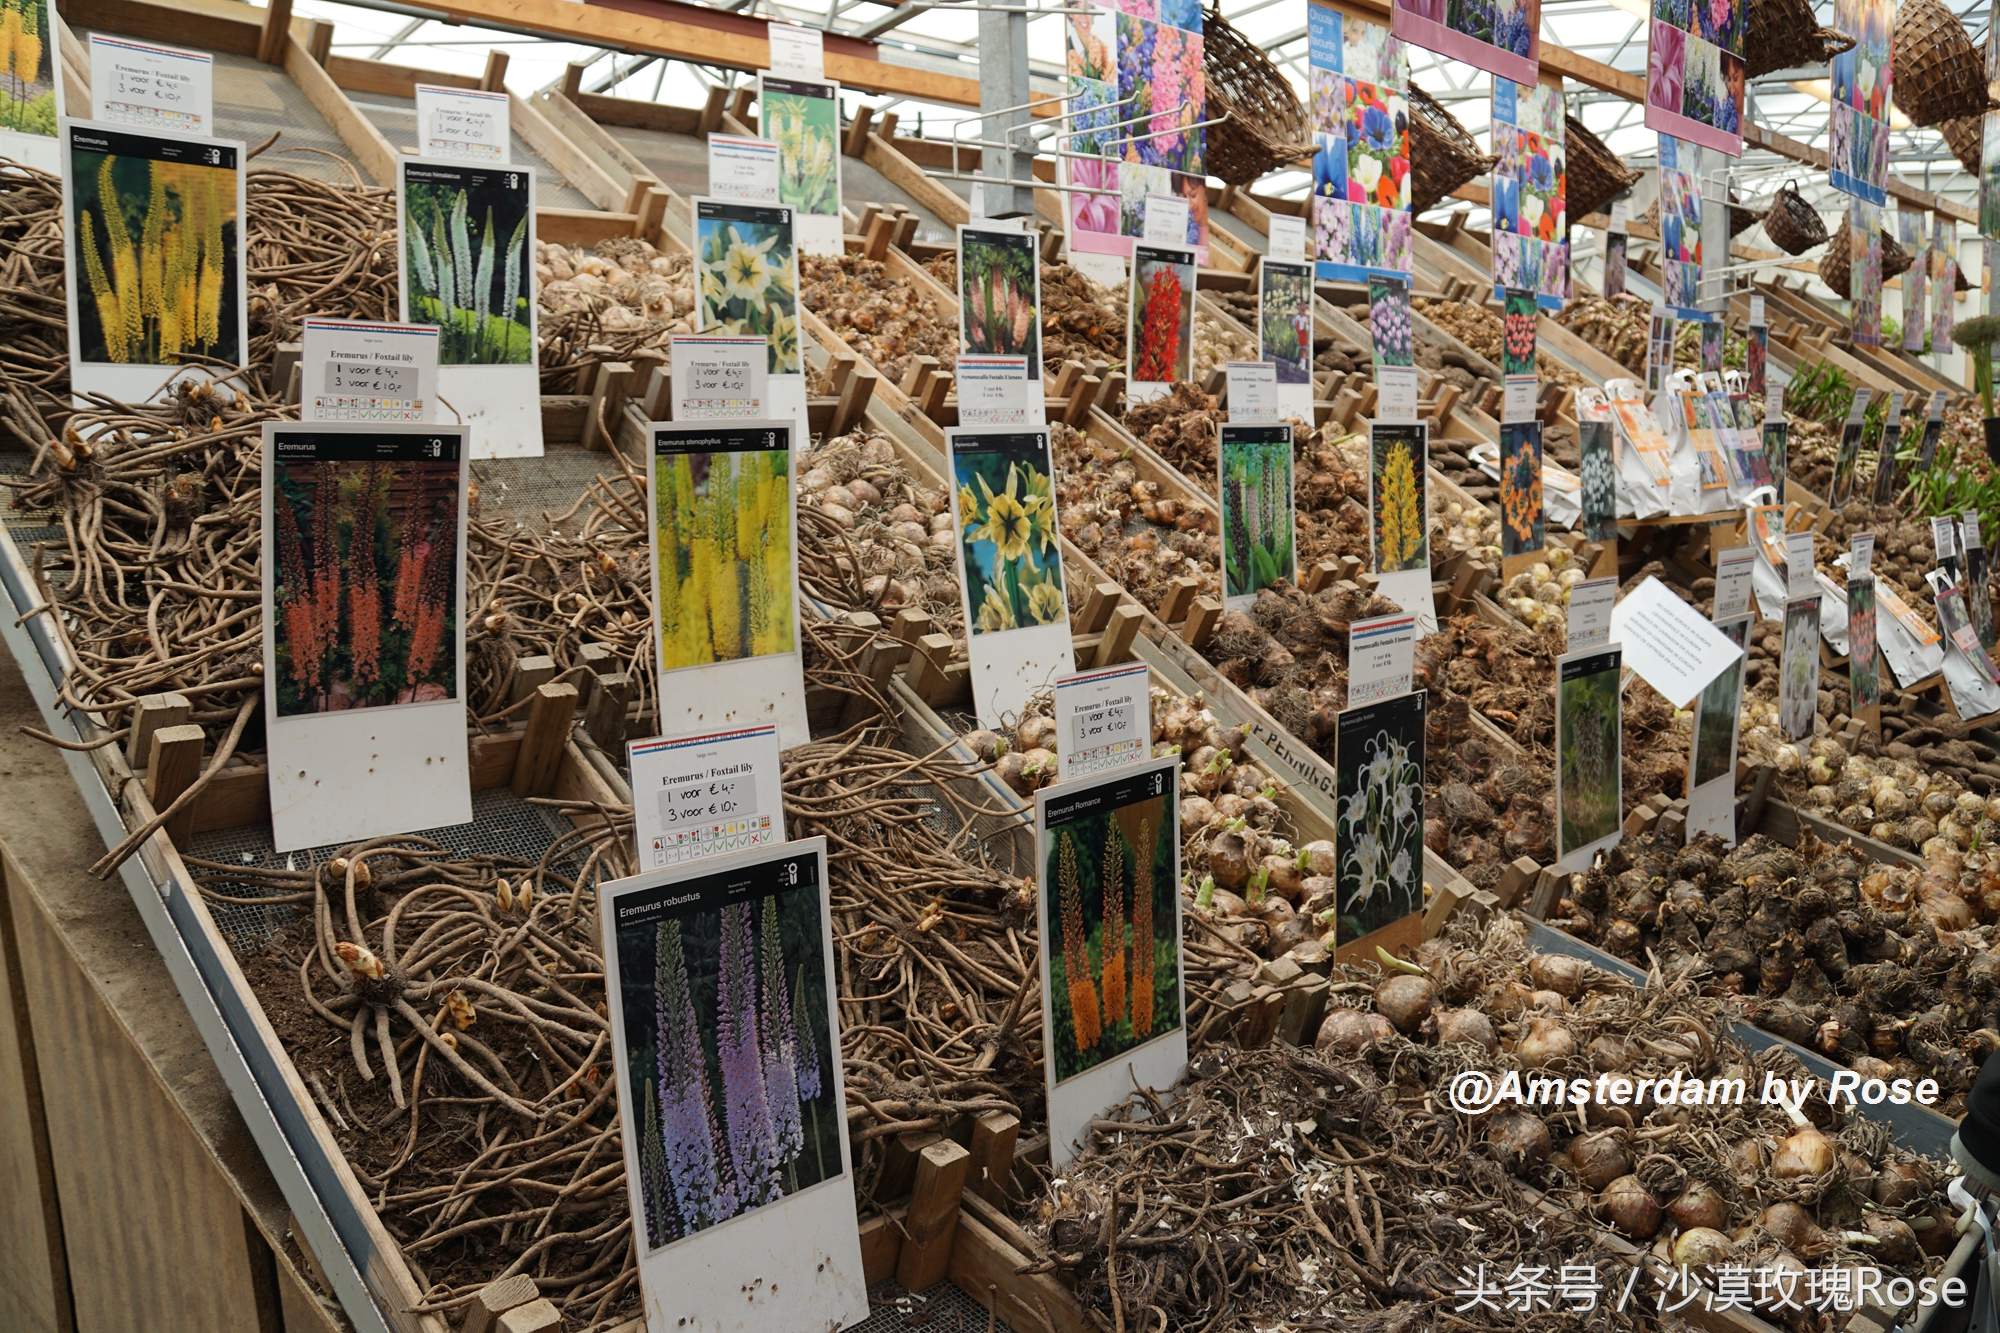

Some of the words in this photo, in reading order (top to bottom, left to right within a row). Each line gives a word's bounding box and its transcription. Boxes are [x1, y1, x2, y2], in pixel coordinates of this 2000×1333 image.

[1310, 8, 1334, 26] Choose
[1311, 49, 1337, 66] specialty
[116, 64, 149, 75] Eremurus
[156, 70, 178, 80] Foxtail
[119, 83, 125, 92] 3
[73, 135, 108, 146] Eremurus
[331, 351, 368, 359] Eremurus
[402, 354, 413, 363] lily
[337, 364, 341, 372] 1
[335, 377, 342, 386] 3
[695, 380, 700, 389] 3
[1651, 610, 1680, 634] LIEFERSERVICE
[1684, 636, 1702, 652] EUROPA
[1656, 602, 1675, 618] DELIVERY
[1674, 616, 1691, 631] SERVICE
[1694, 633, 1712, 648] EUROPE
[1637, 610, 1653, 625] SERVICE
[1658, 628, 1680, 646] LIVRAISON
[1685, 649, 1703, 665] EUROPA
[1646, 642, 1666, 659] ENTREGA
[1670, 662, 1688, 678] EUROPA
[1651, 634, 1674, 654] CONSEGNA
[1678, 656, 1696, 672] EUROPA
[1075, 703, 1101, 713] Eremurus
[1105, 698, 1123, 707] Foxtail
[1089, 713, 1104, 721] voor
[1080, 728, 1086, 738] 3
[663, 772, 704, 786] Eremurus
[711, 765, 738, 777] Foxtail
[741, 763, 753, 773] lily
[668, 792, 670, 802] 1
[681, 788, 701, 799] voor
[668, 809, 678, 821] 3
[680, 807, 704, 818] voor
[1048, 805, 1074, 817] Eremurus
[1075, 797, 1101, 809] Romance
[620, 902, 661, 918] Eremurus
[664, 892, 700, 908] robustus
